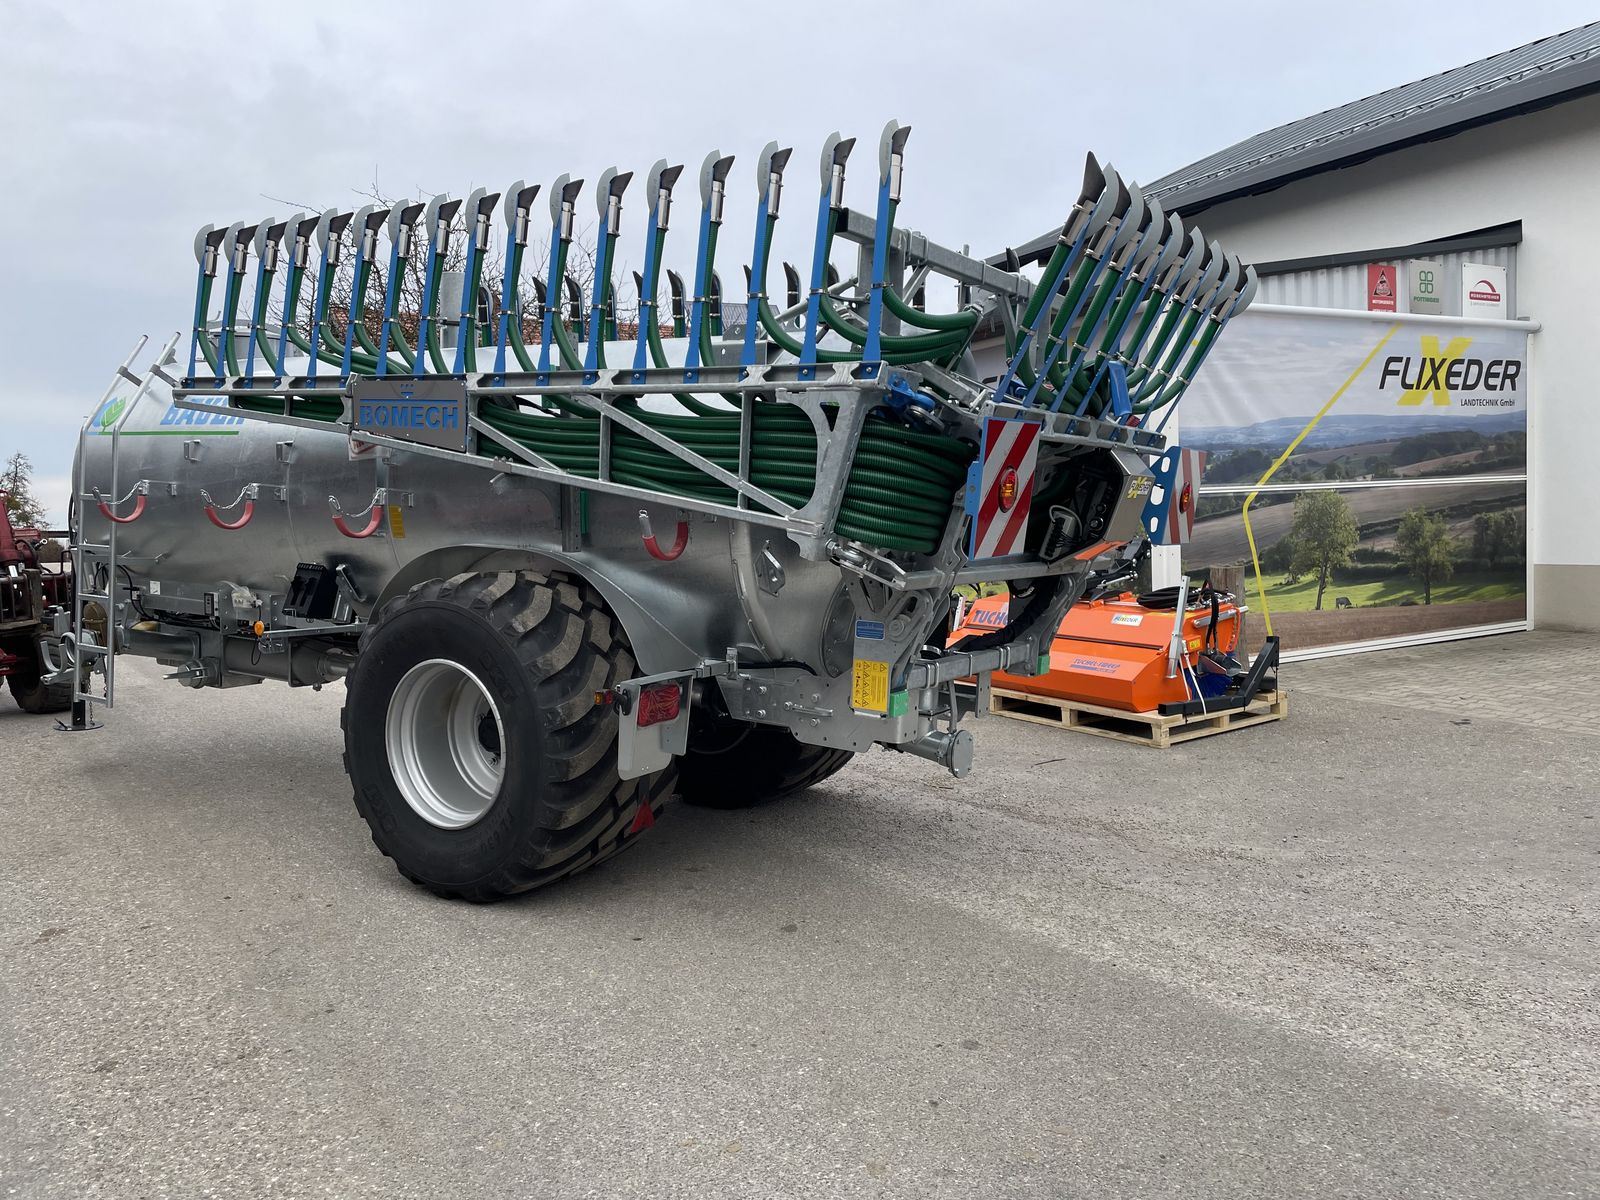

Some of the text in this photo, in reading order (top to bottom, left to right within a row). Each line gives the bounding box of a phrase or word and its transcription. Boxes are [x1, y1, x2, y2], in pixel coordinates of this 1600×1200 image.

[1379, 356, 1521, 391] FLIXEDER
[1460, 399, 1499, 407] LANDTECHNIK
[359, 405, 459, 430] BOMECH
